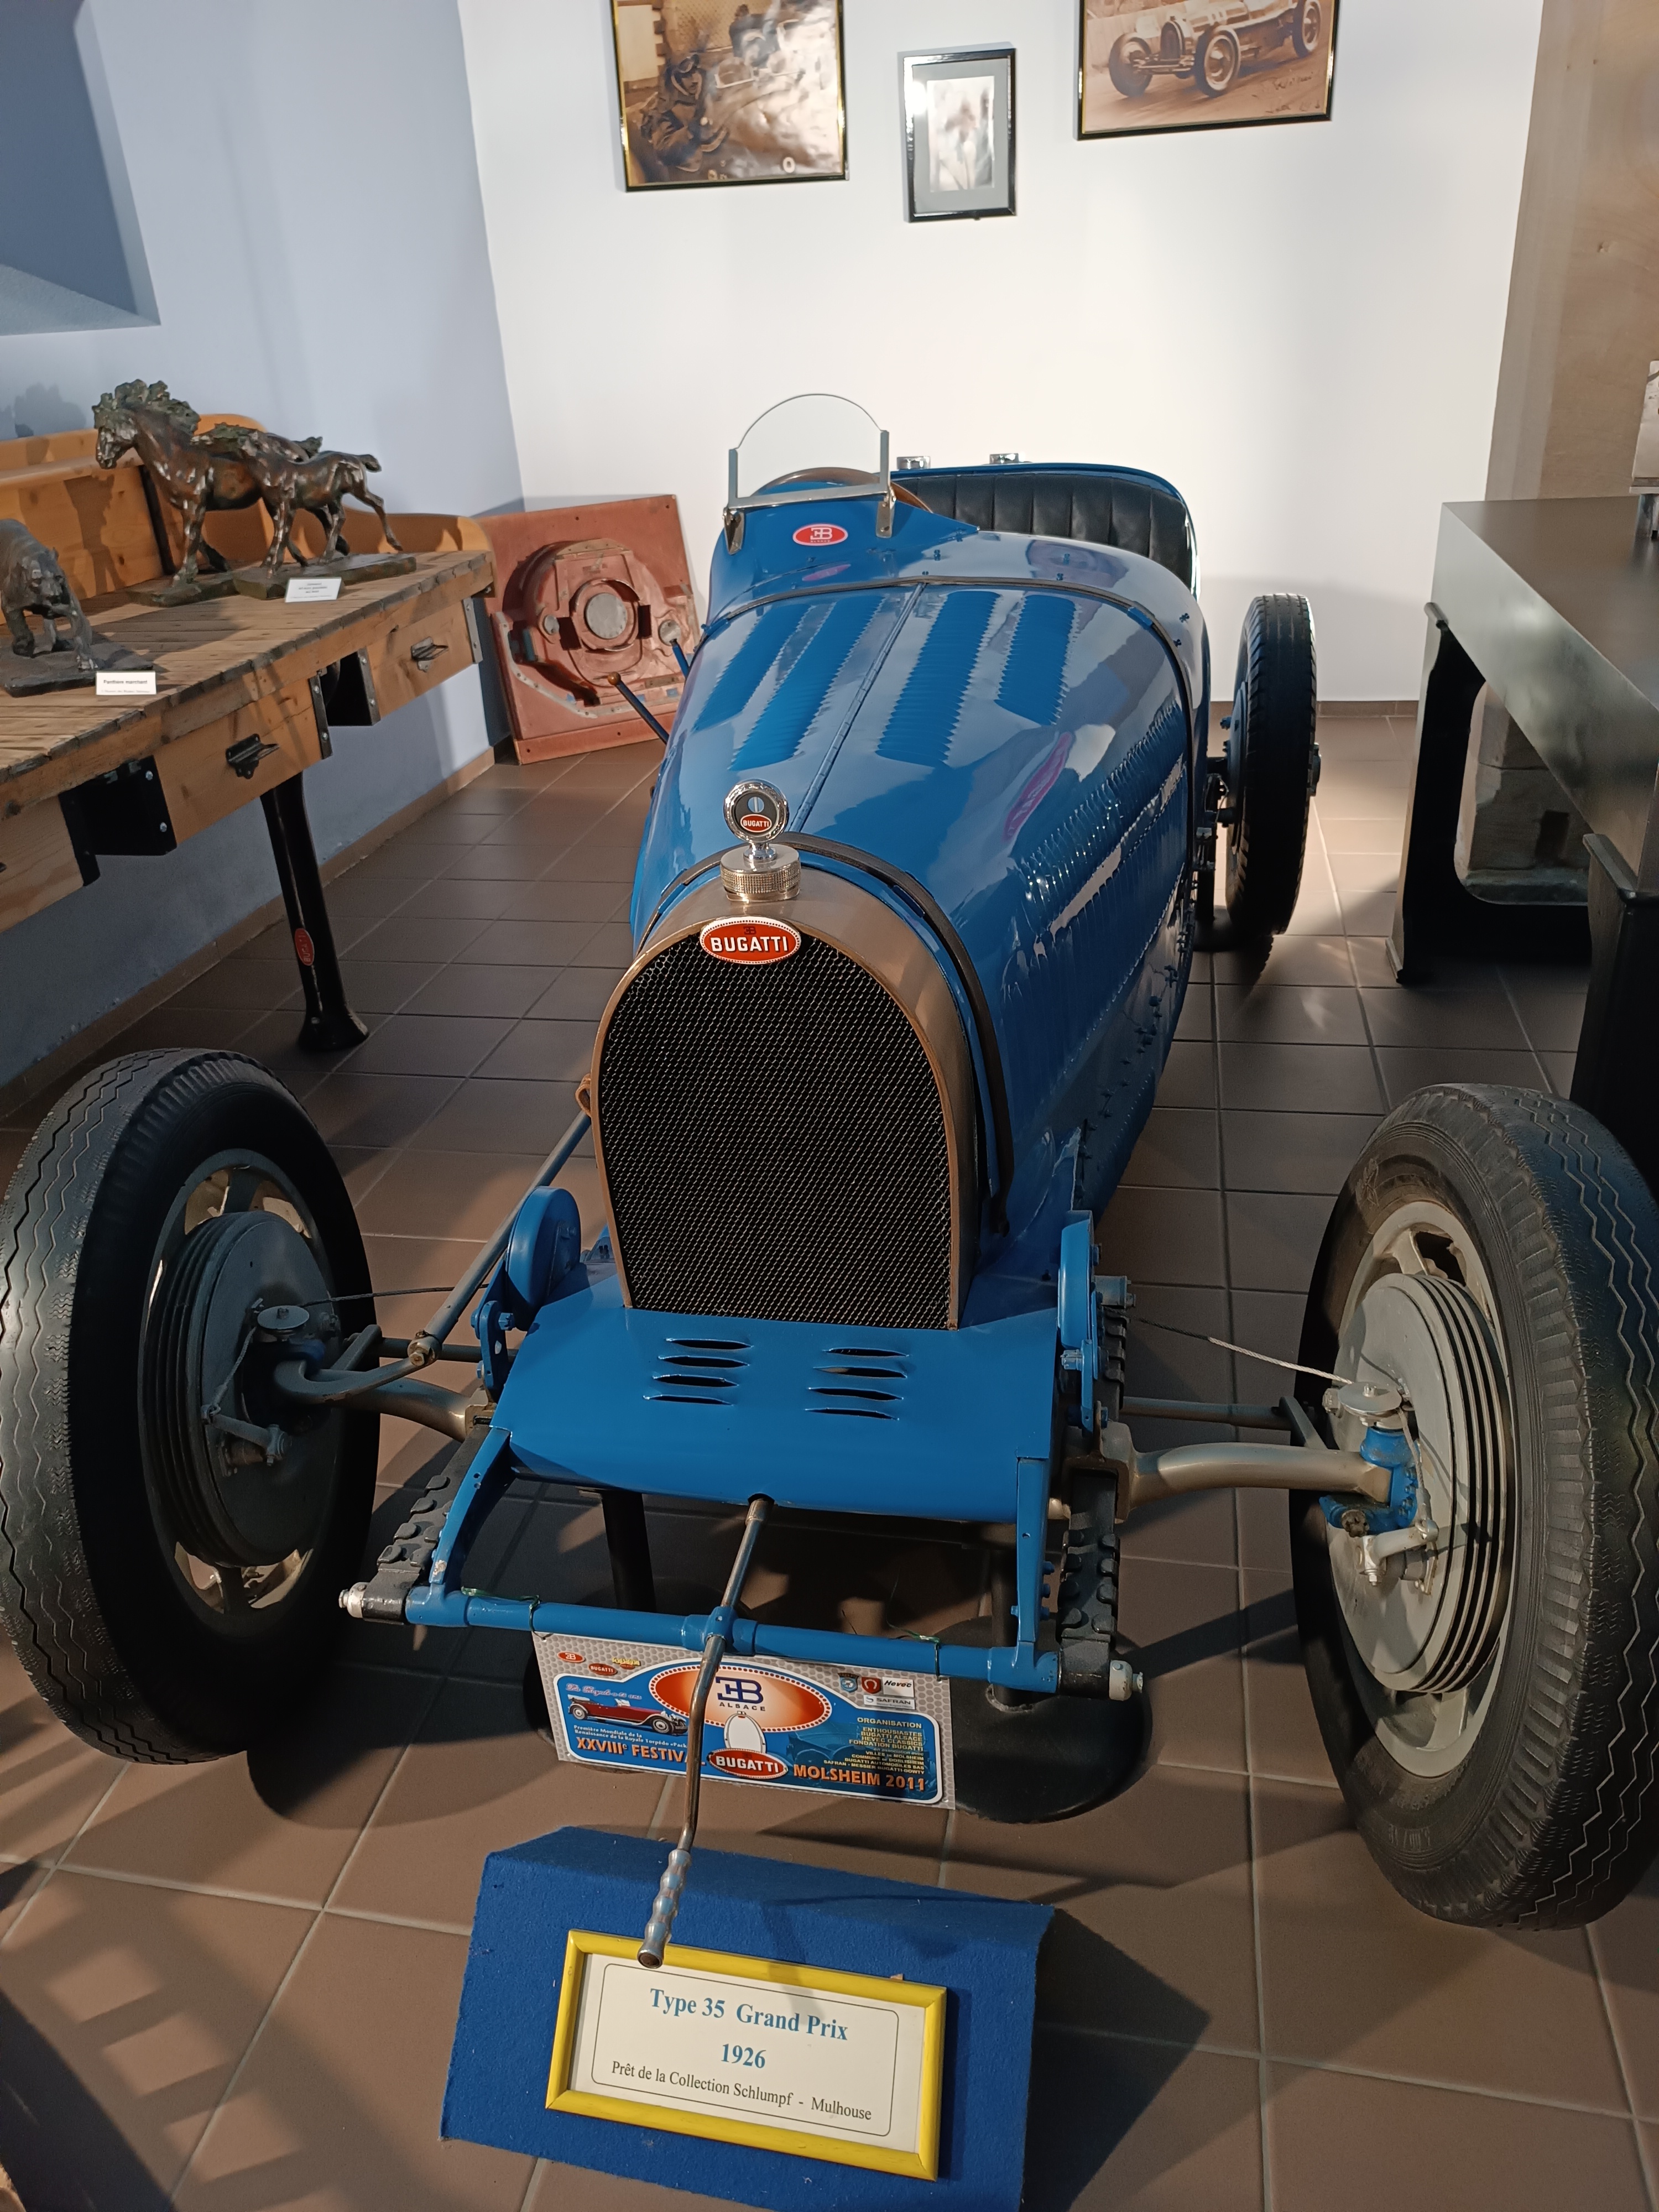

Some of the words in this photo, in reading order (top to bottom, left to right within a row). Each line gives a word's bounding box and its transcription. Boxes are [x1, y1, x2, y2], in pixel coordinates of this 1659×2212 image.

[710, 936, 788, 952] BUGATTI
[590, 1665, 613, 1673] BUGATTI
[719, 1702, 766, 1712] ALSACE
[857, 1717, 922, 1729] ORGANISATION
[575, 1729, 609, 1738] Renaissance
[860, 1731, 891, 1739] BUGATTI
[863, 1726, 922, 1737] ENTHOUSIASTES
[849, 1739, 890, 1748] FONDATION
[892, 1743, 924, 1751] BUGATTI
[632, 1744, 705, 1766] FESTIV
[716, 1755, 779, 1773] BUGATTI
[870, 1760, 911, 1768] AUTOMOBILES
[793, 1763, 880, 1787] MOLSHEIM
[885, 1772, 925, 1792] 2011
[650, 1987, 697, 2018] Type
[702, 1997, 726, 2019] 35
[736, 2002, 800, 2032] Grand
[806, 2014, 848, 2041] Prix
[721, 2043, 766, 2069] 1926
[611, 2060, 635, 2077] Prêt
[638, 2065, 652, 2079] de
[655, 2067, 666, 2083] la
[669, 2070, 730, 2096] Collection
[733, 2082, 794, 2107] Schlumpf
[811, 2097, 872, 2121] Mulhouse
